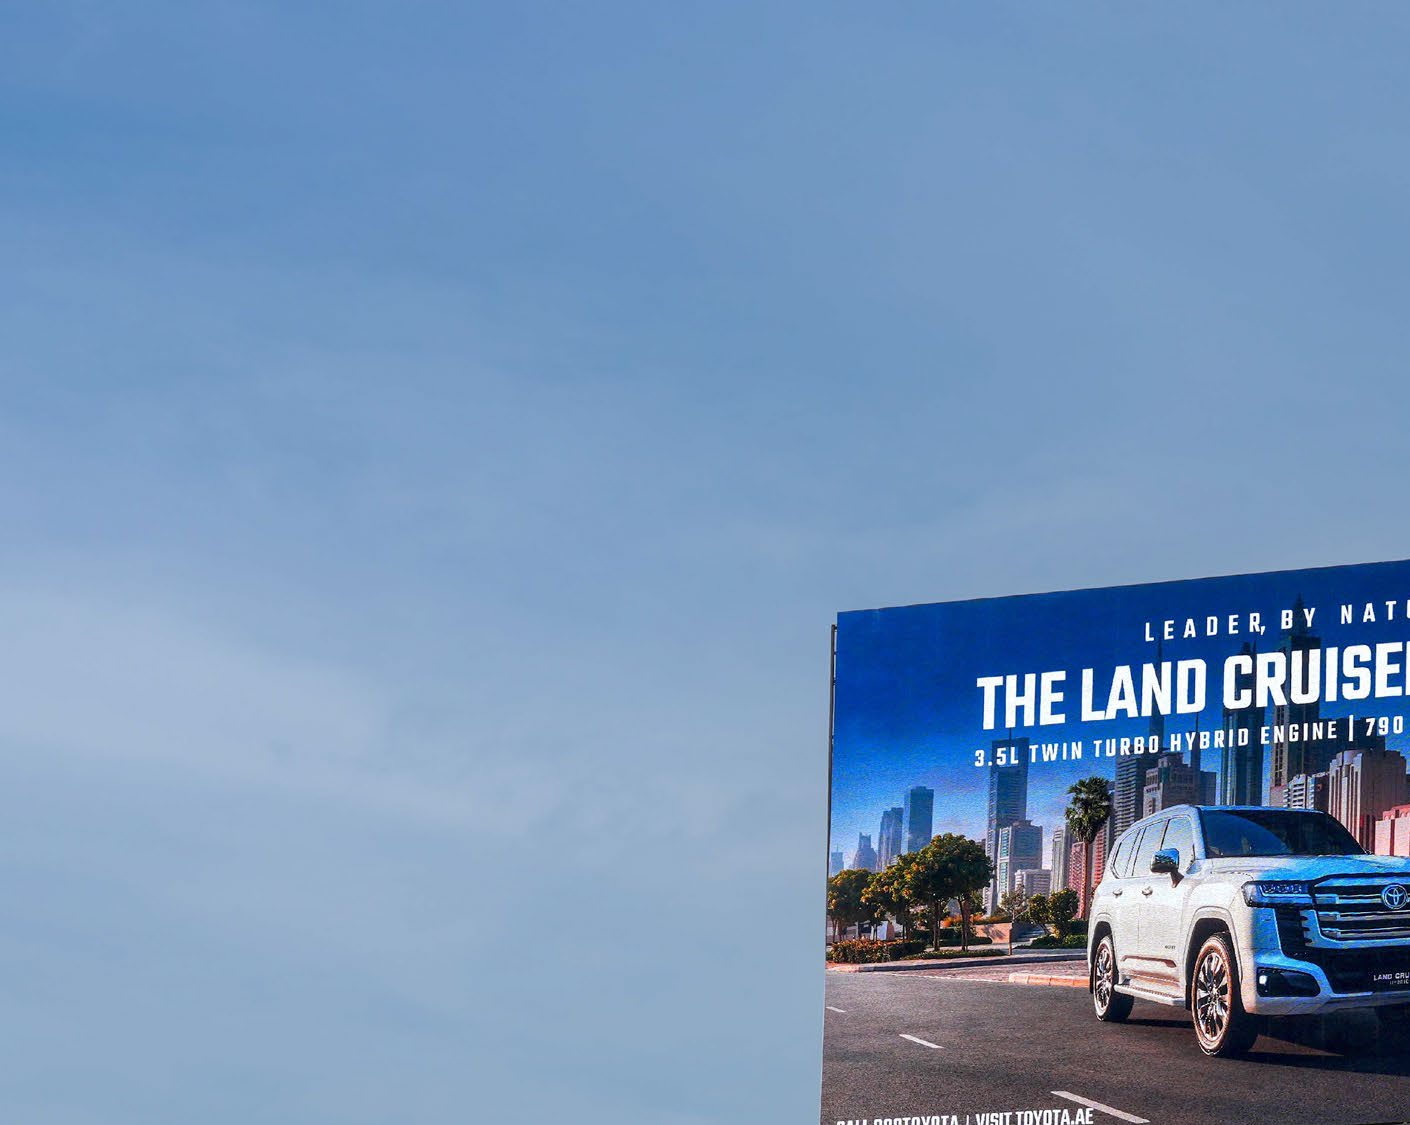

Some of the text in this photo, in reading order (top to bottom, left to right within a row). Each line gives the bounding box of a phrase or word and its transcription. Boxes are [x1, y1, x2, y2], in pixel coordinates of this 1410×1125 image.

[1145, 612, 1266, 642] LEADER,
[1281, 608, 1316, 630] BY
[976, 670, 1067, 730] THE
[1081, 658, 1207, 722] LAND
[974, 746, 1019, 767] 3.5L
[1029, 741, 1083, 763] TWIN
[1093, 735, 1159, 758] TURBO
[1170, 728, 1249, 752] HYBRID
[1260, 720, 1338, 745] ENGINE
[1365, 714, 1404, 737] 790
